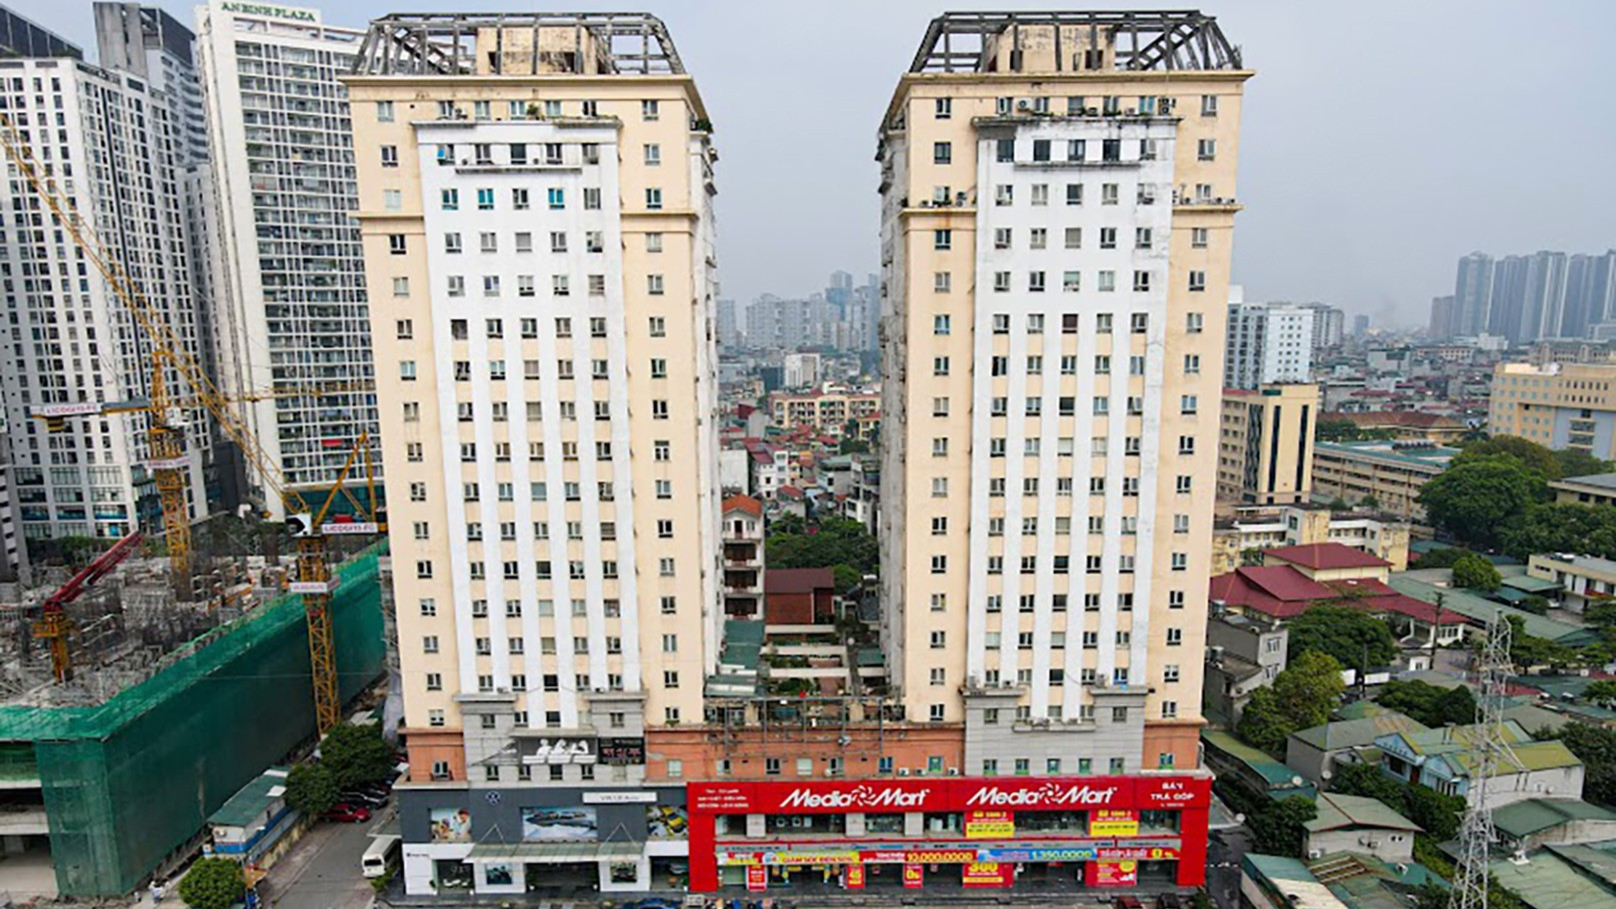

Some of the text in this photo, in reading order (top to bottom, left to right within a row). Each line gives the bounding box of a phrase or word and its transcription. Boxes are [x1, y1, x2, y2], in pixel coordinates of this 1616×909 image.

[221, 2, 240, 11] AN
[275, 8, 316, 22] PLAZA
[779, 787, 928, 807] Media Mart
[966, 785, 1117, 805] Media Mart
